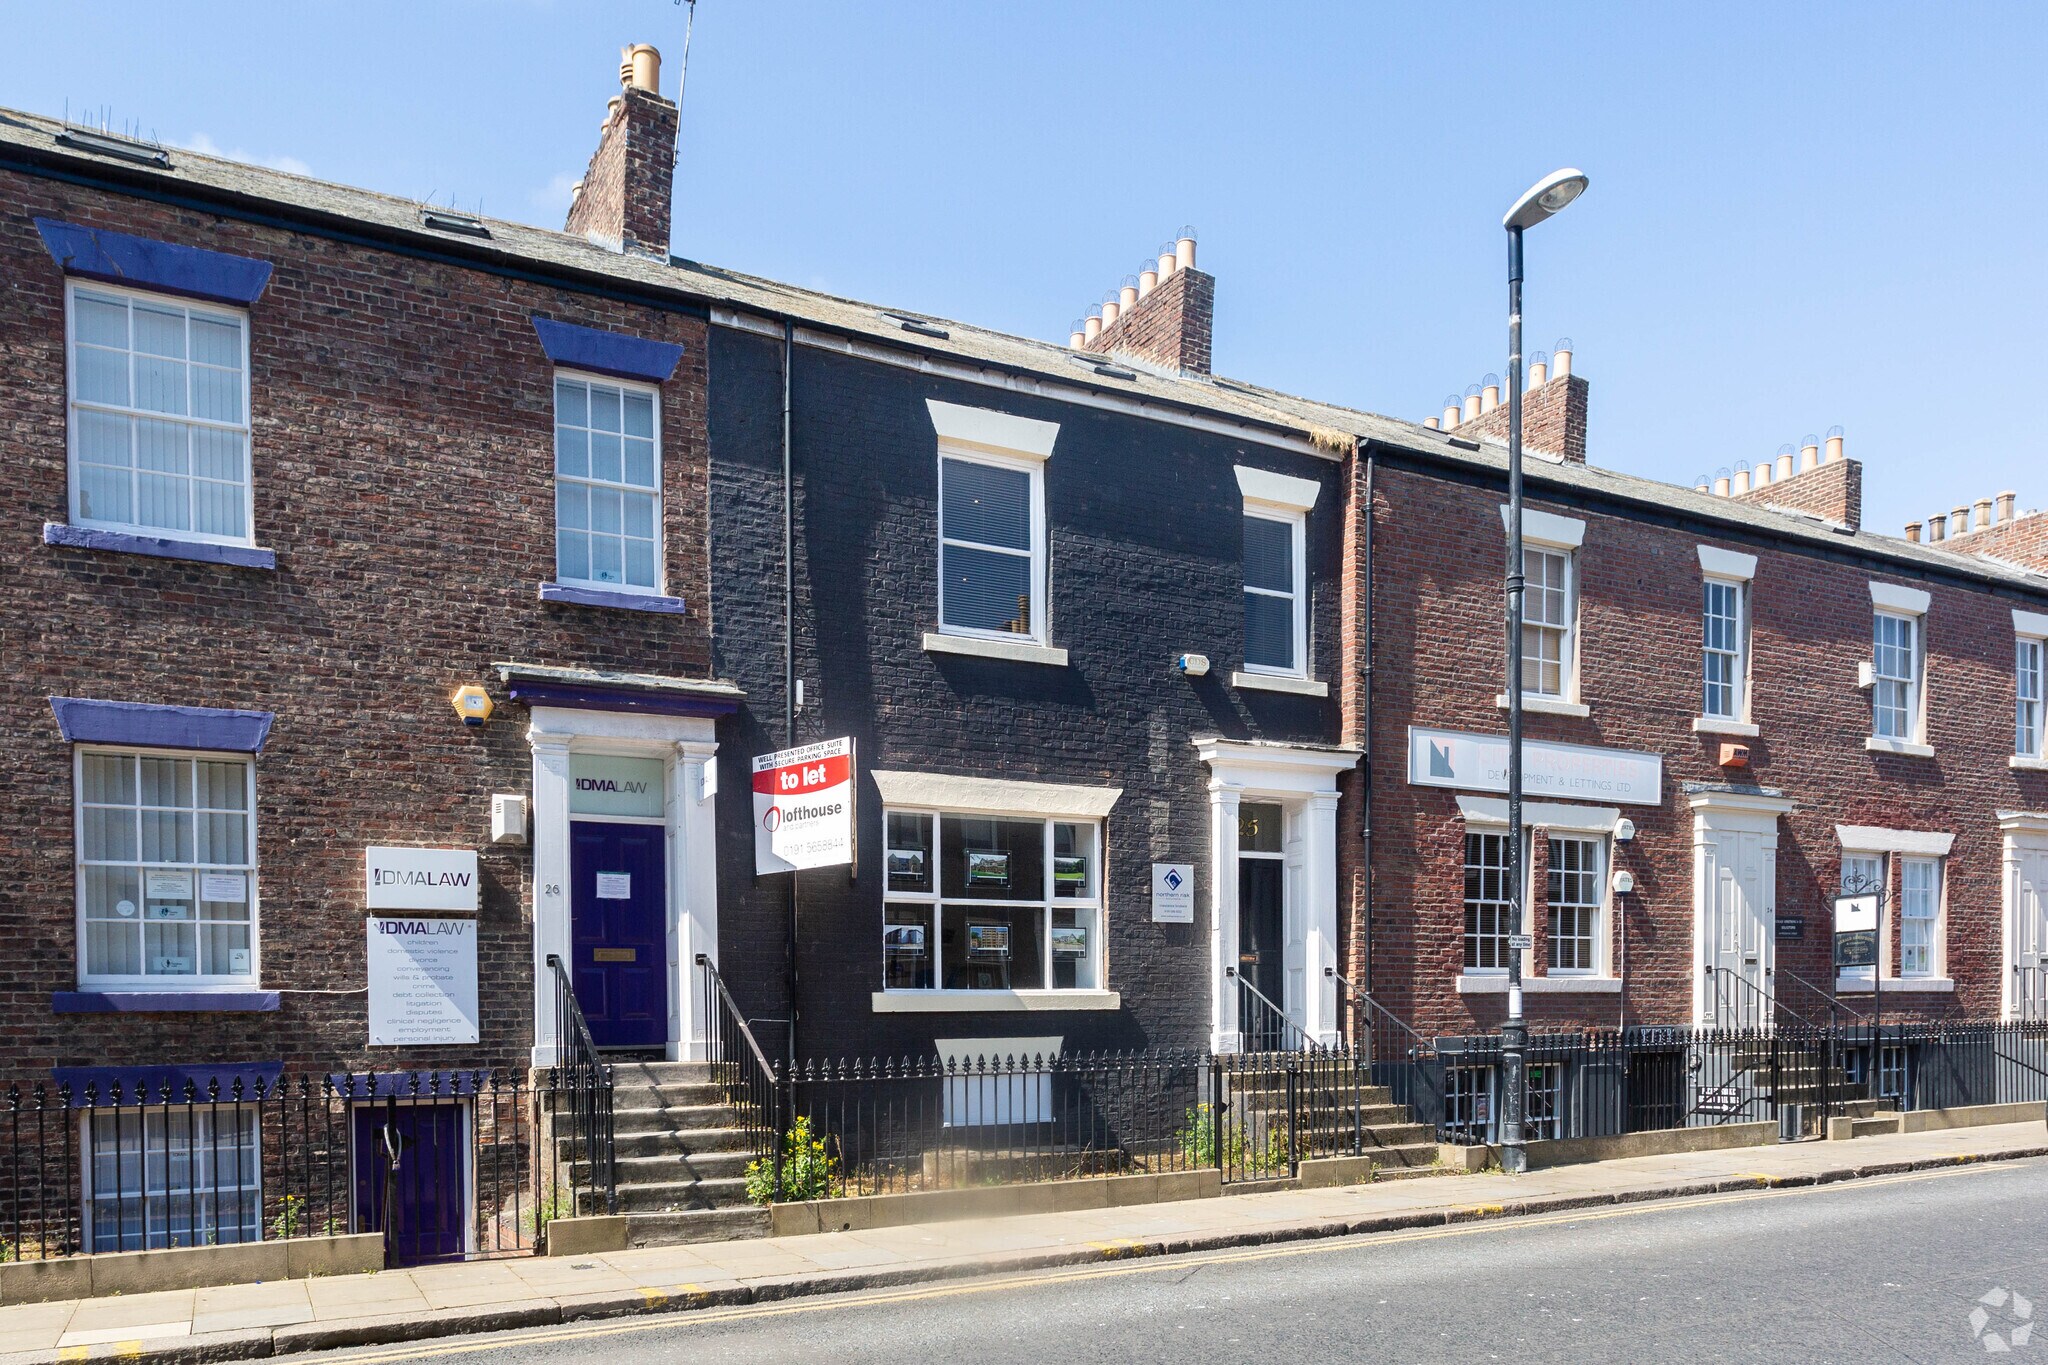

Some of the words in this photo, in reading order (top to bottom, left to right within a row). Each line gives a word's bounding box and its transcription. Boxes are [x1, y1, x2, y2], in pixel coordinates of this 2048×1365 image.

[760, 762, 774, 770] WITH
[774, 757, 795, 768] SECURE
[797, 752, 821, 763] PARKING
[824, 747, 841, 757] SPACE
[774, 748, 805, 759] PRESENTED
[806, 743, 824, 753] OFFICE
[827, 740, 842, 748] SUITE
[780, 771, 799, 790] to
[802, 764, 826, 786] let
[1558, 776, 1565, 786] &
[1569, 778, 1612, 791] LETTINGS
[1616, 782, 1632, 793] LTD
[782, 803, 842, 823] lofthouse
[783, 843, 803, 857] 0191
[545, 884, 560, 895] 26
